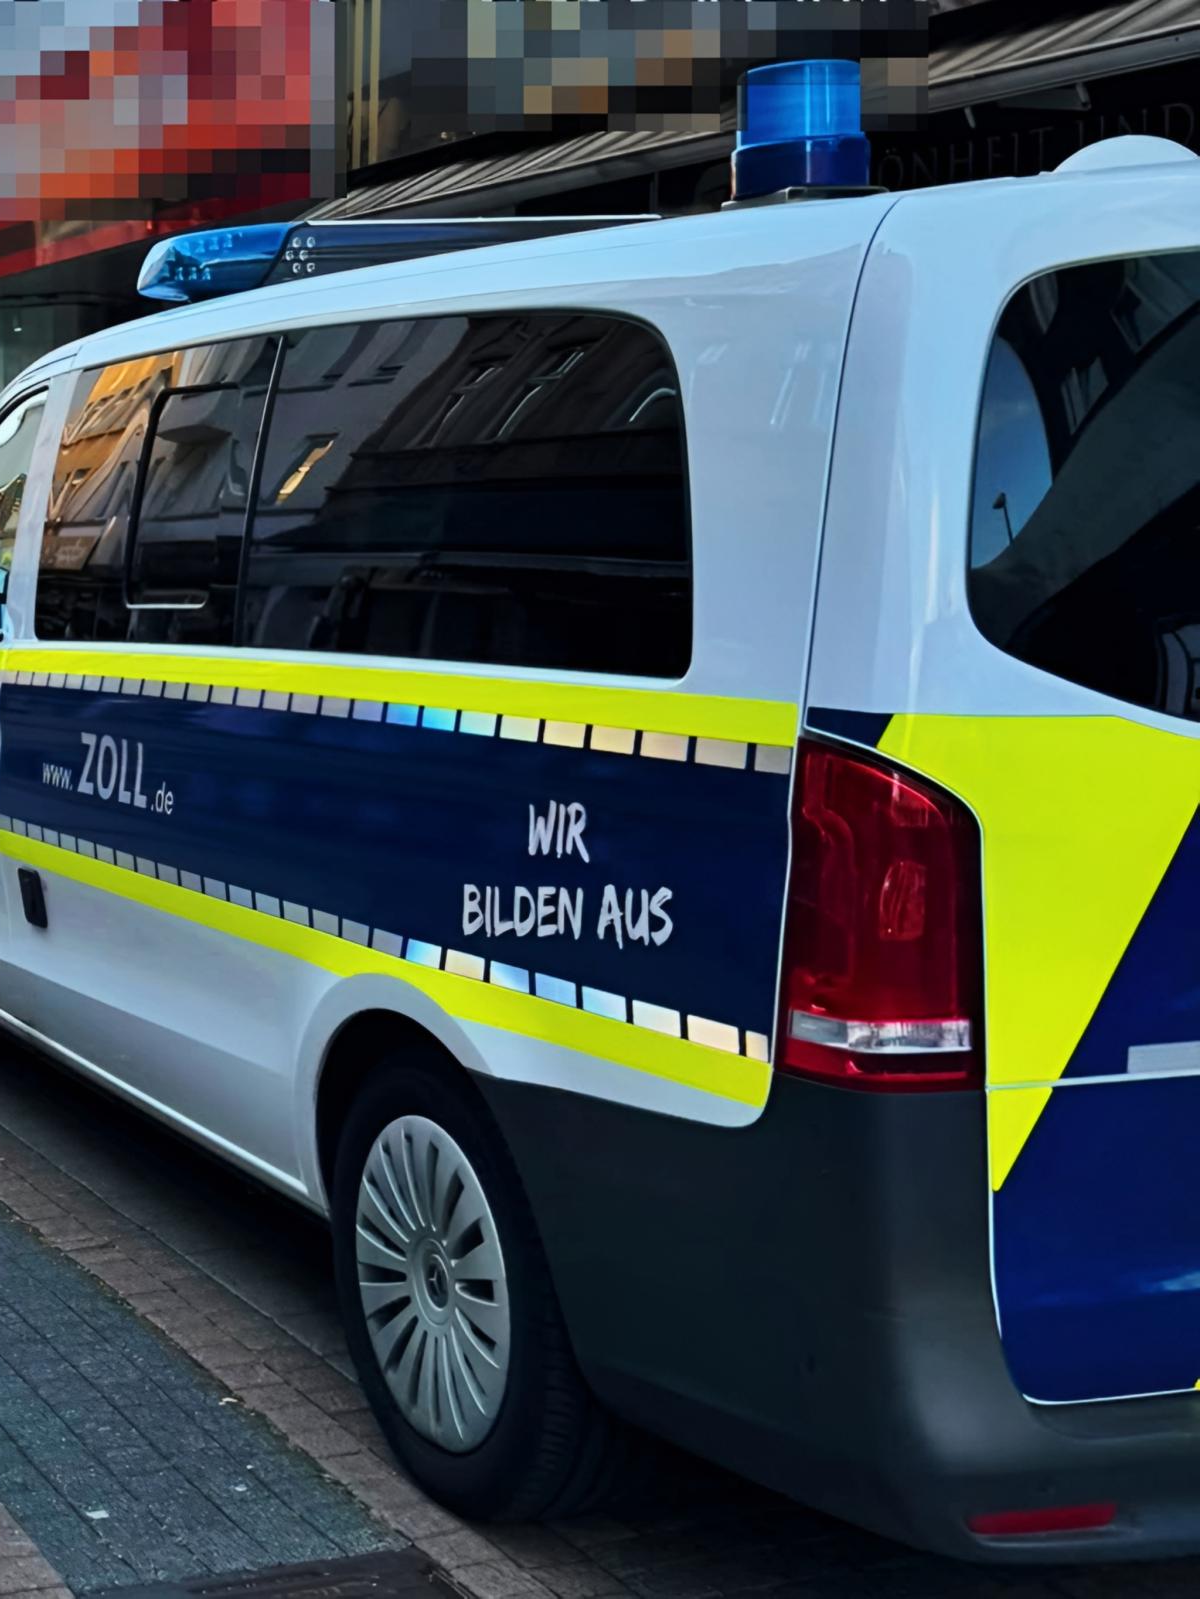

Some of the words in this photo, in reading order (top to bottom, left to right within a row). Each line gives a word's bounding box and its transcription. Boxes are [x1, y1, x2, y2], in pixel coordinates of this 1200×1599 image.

[876, 126, 1055, 187] ÖNHEIT
[528, 800, 590, 863] WIR
[462, 883, 584, 940] BILDEN
[597, 884, 674, 950] AUS
